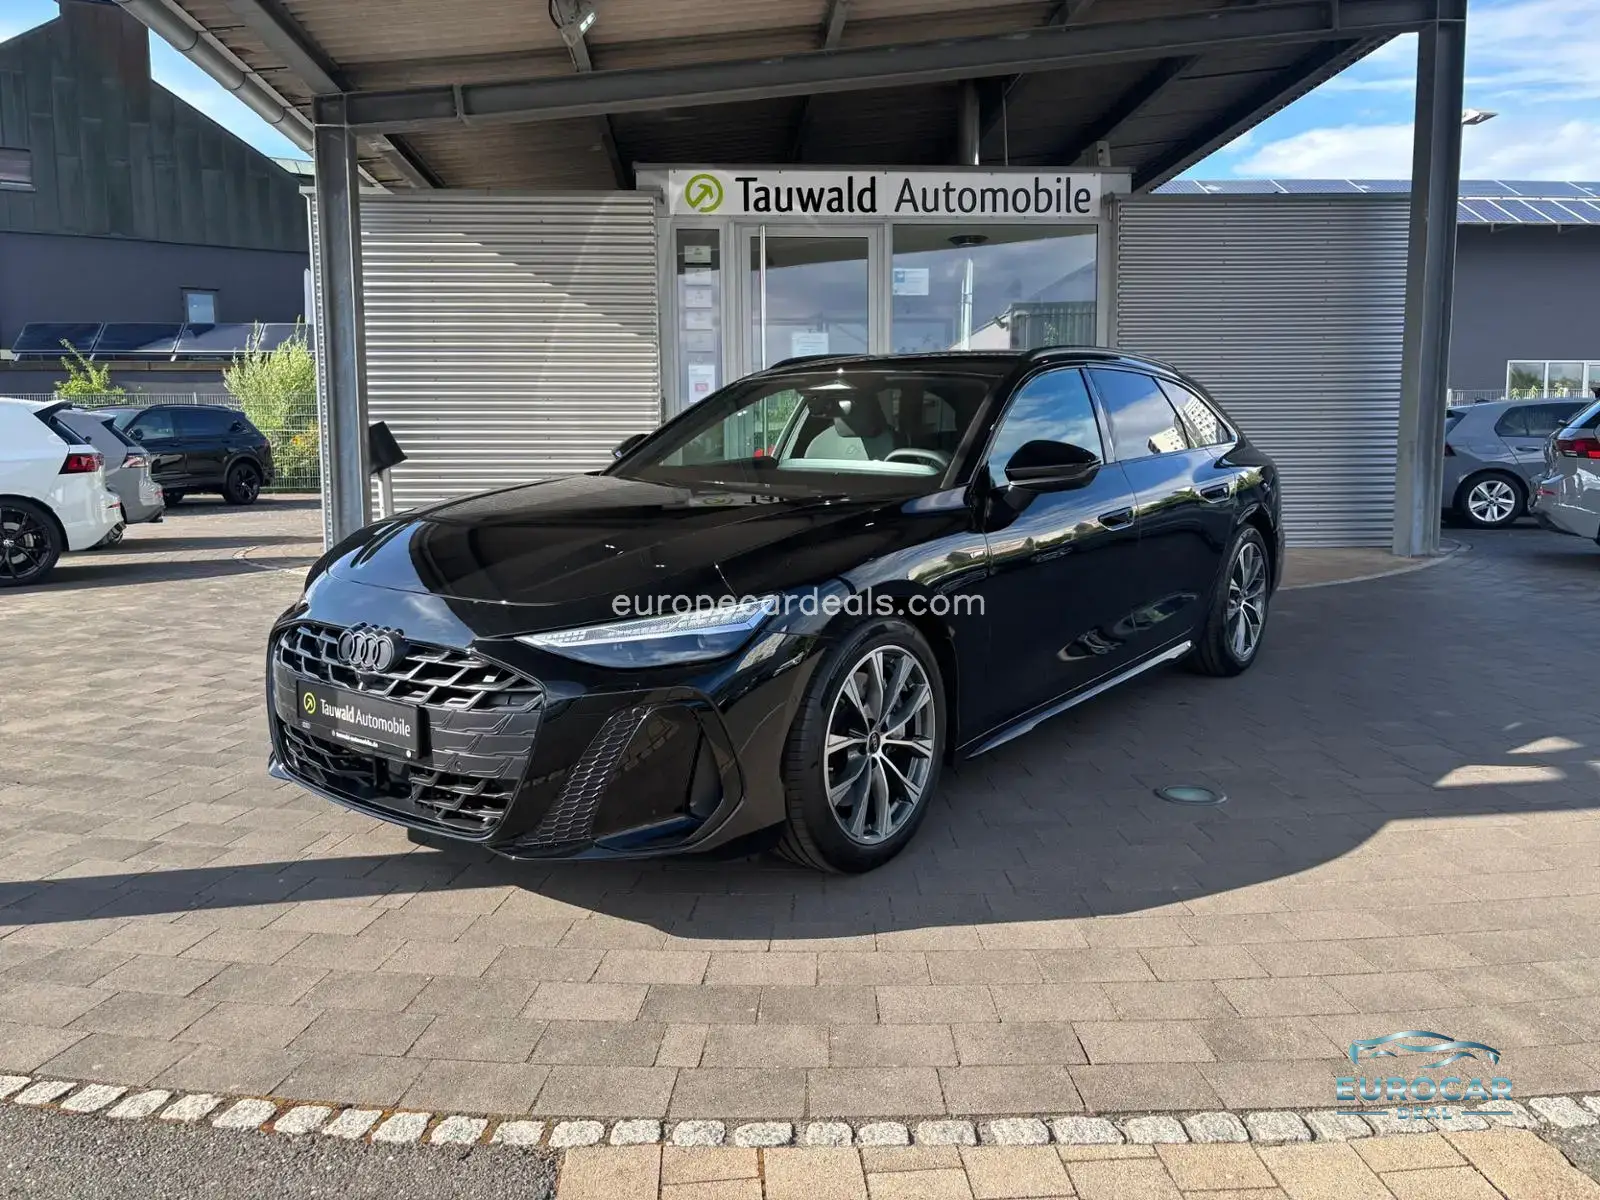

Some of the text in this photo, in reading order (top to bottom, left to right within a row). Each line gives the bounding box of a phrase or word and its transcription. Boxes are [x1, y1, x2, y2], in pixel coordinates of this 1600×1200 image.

[735, 176, 1091, 214] Tauwald Automobile
[320, 698, 411, 737] Tauwald Automobile
